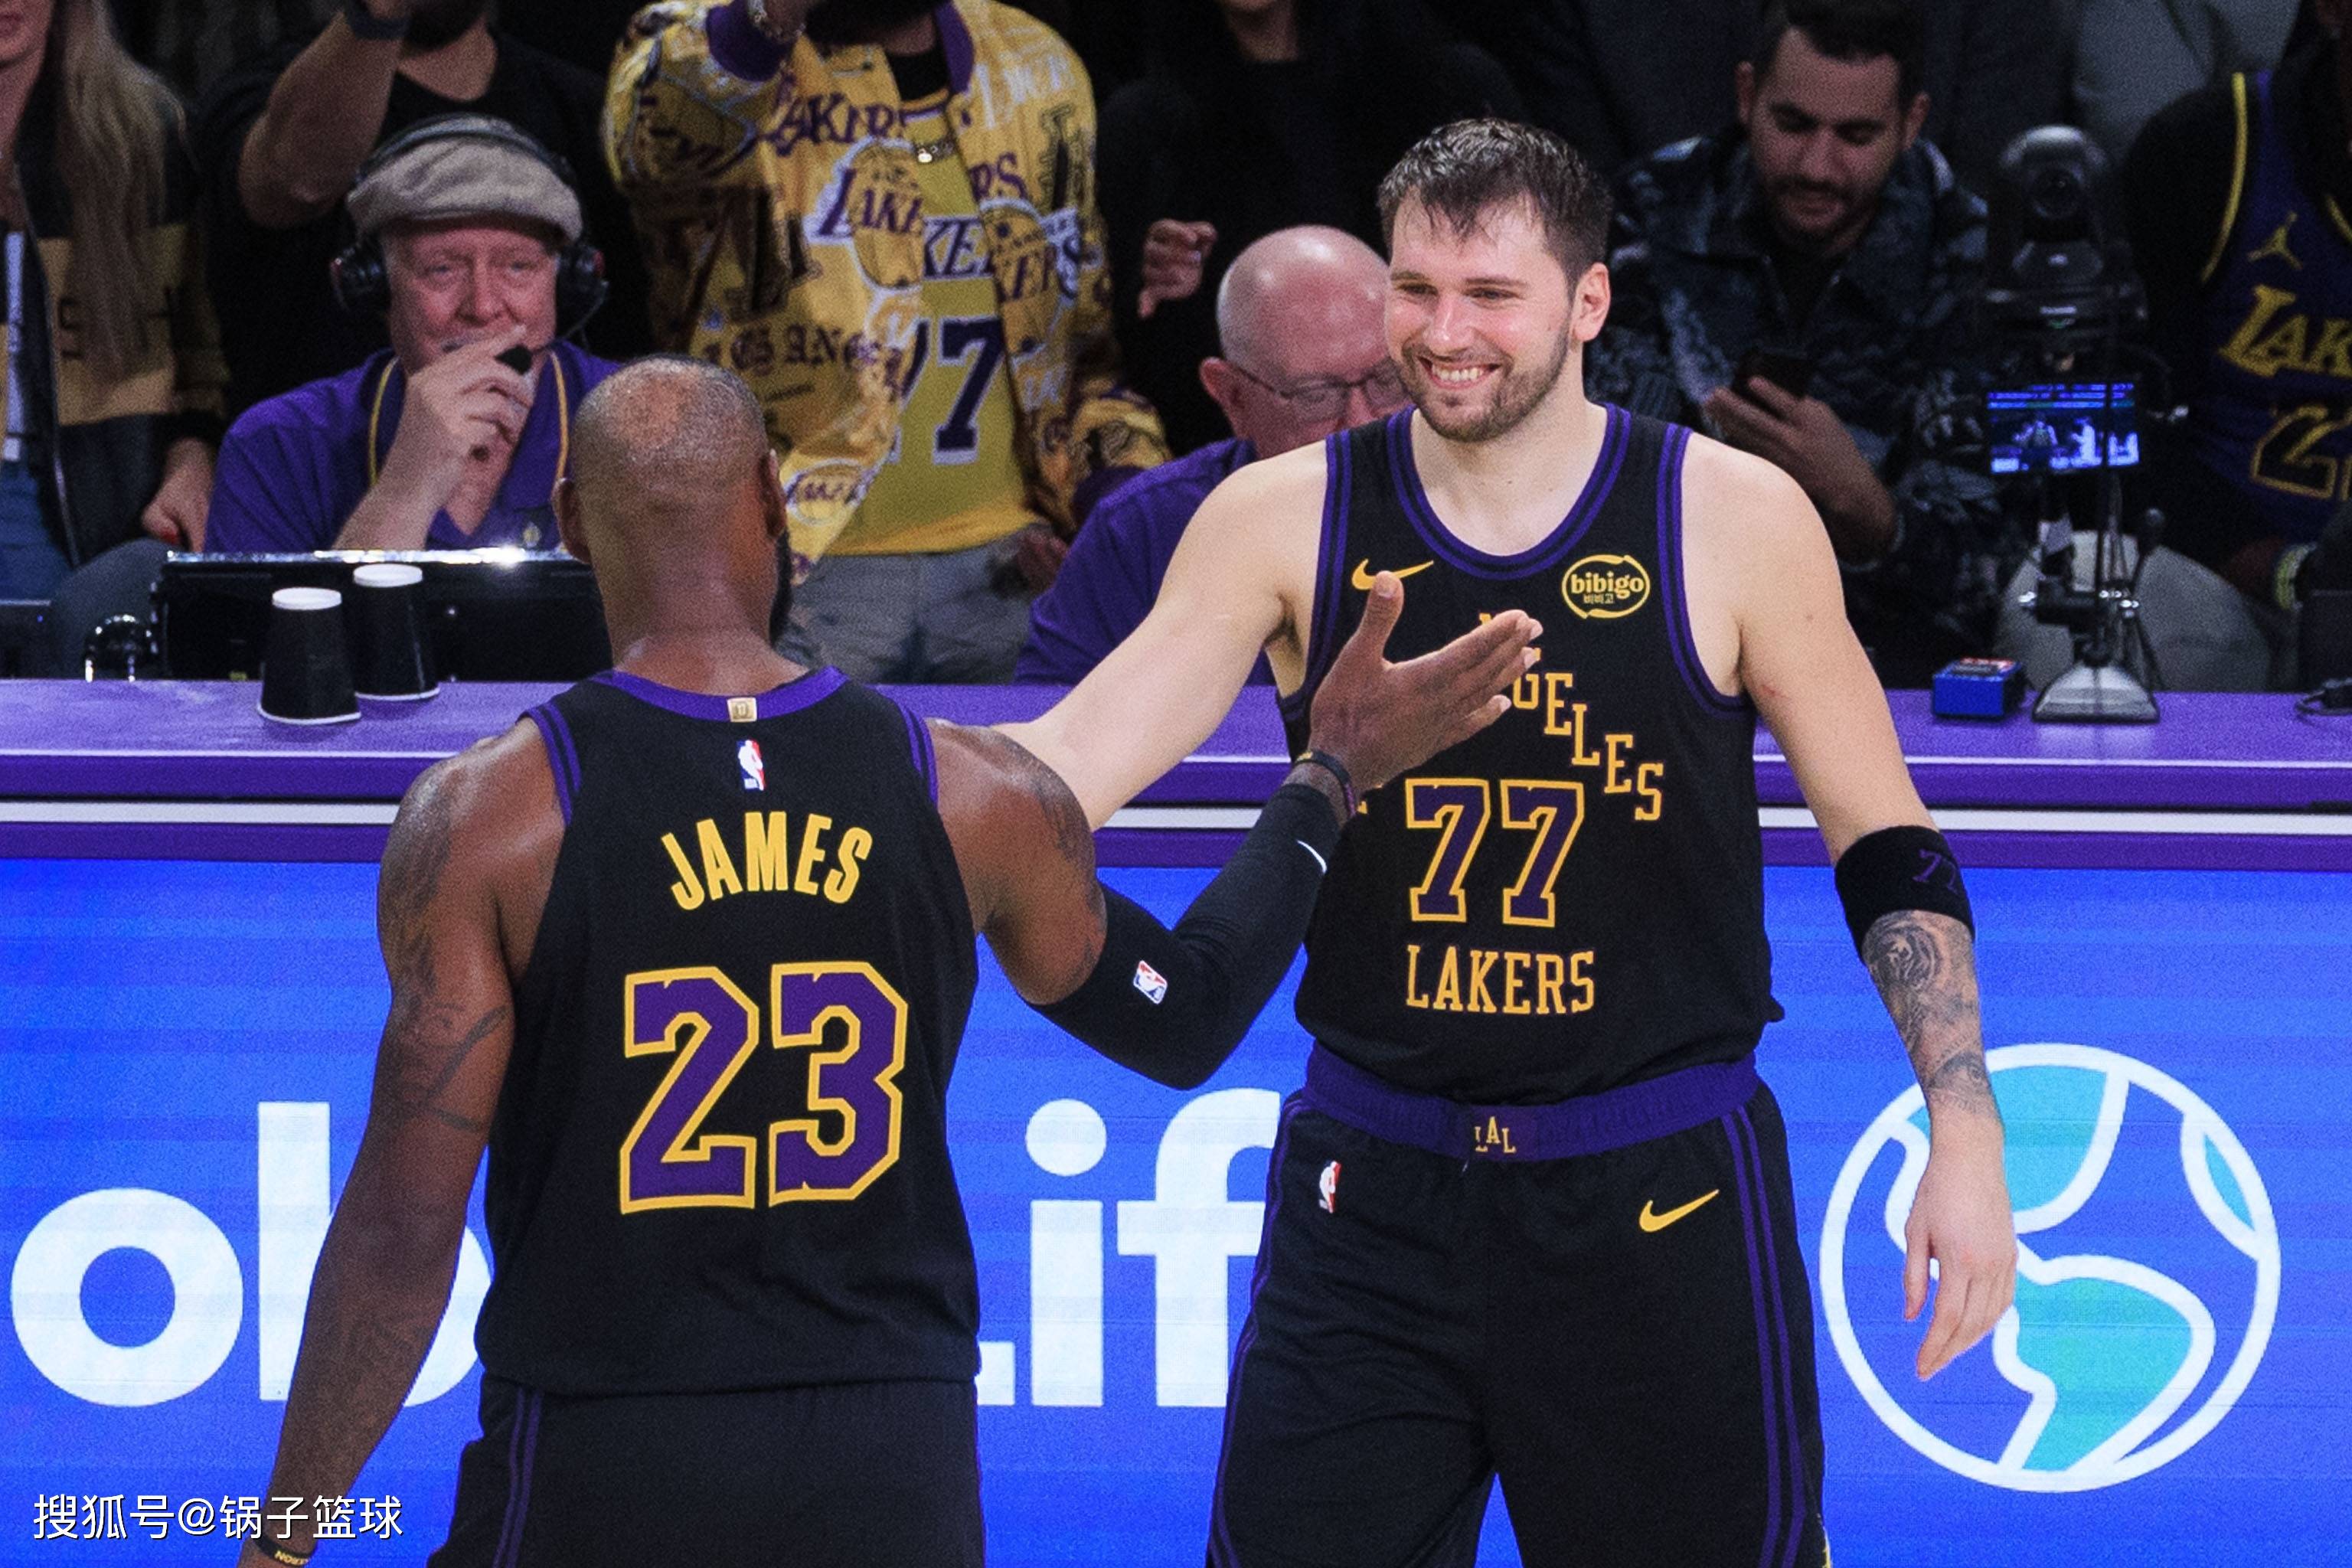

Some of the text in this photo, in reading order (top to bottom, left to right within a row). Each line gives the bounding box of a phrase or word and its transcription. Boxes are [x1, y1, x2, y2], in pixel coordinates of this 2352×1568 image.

[924, 217, 998, 277] KE
[2251, 402, 2352, 501] 2
[1571, 570, 1645, 599] bibigo
[1479, 612, 1664, 822] GELES
[661, 811, 873, 910] JAMES
[1406, 778, 1585, 928] 77
[1406, 944, 1595, 1015] LAKERS
[620, 961, 909, 1215] 23
[1475, 1116, 1516, 1153] LAL
[975, 1088, 1280, 1406] if
